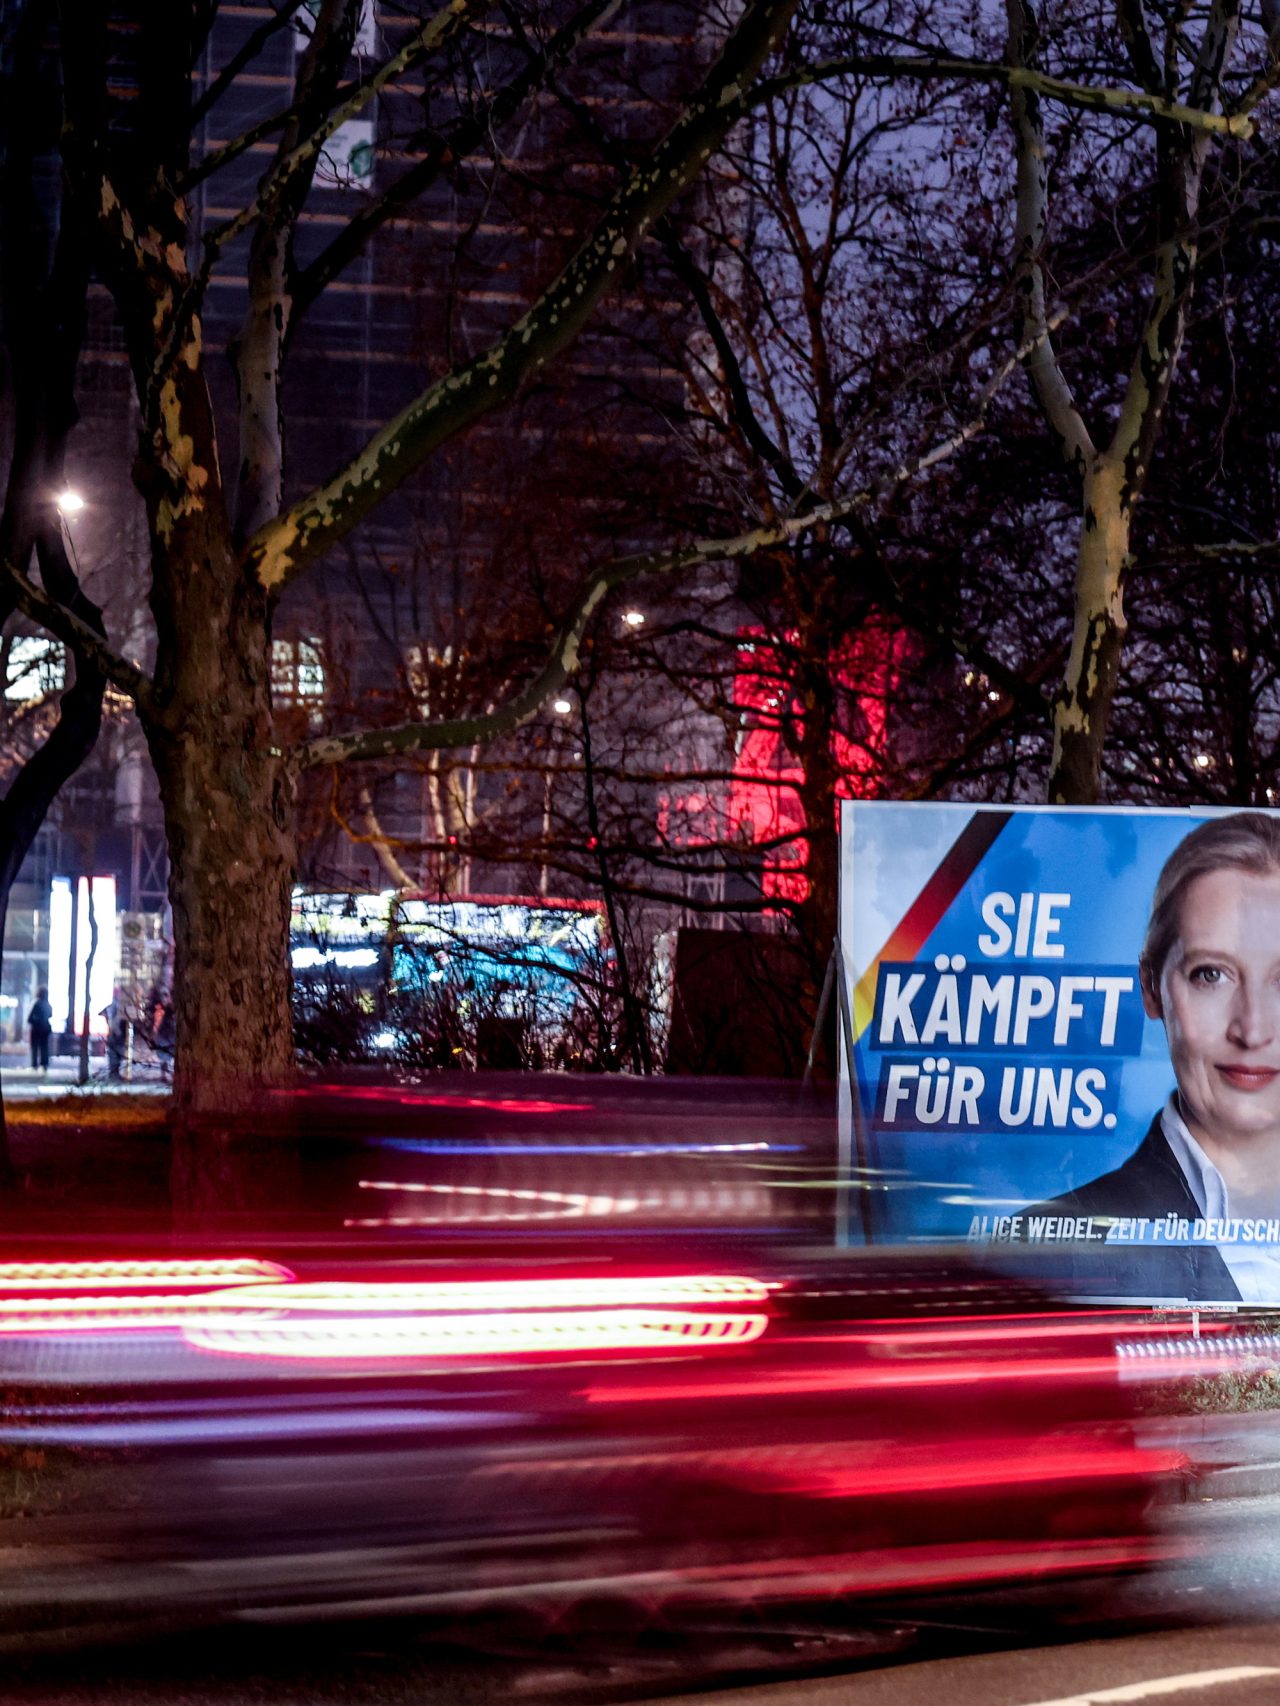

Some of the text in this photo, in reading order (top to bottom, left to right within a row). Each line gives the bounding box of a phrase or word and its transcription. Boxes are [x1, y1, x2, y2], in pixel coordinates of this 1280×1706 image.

[978, 892, 1071, 958] SIE
[879, 954, 1134, 1046] KÄMPFT
[883, 1057, 1117, 1129] FÜR UNS.
[967, 1216, 1023, 1242] ALICE
[1028, 1216, 1103, 1242] WEIDEL.
[1106, 1217, 1149, 1240] ZEIT
[1153, 1212, 1189, 1241] FÜR
